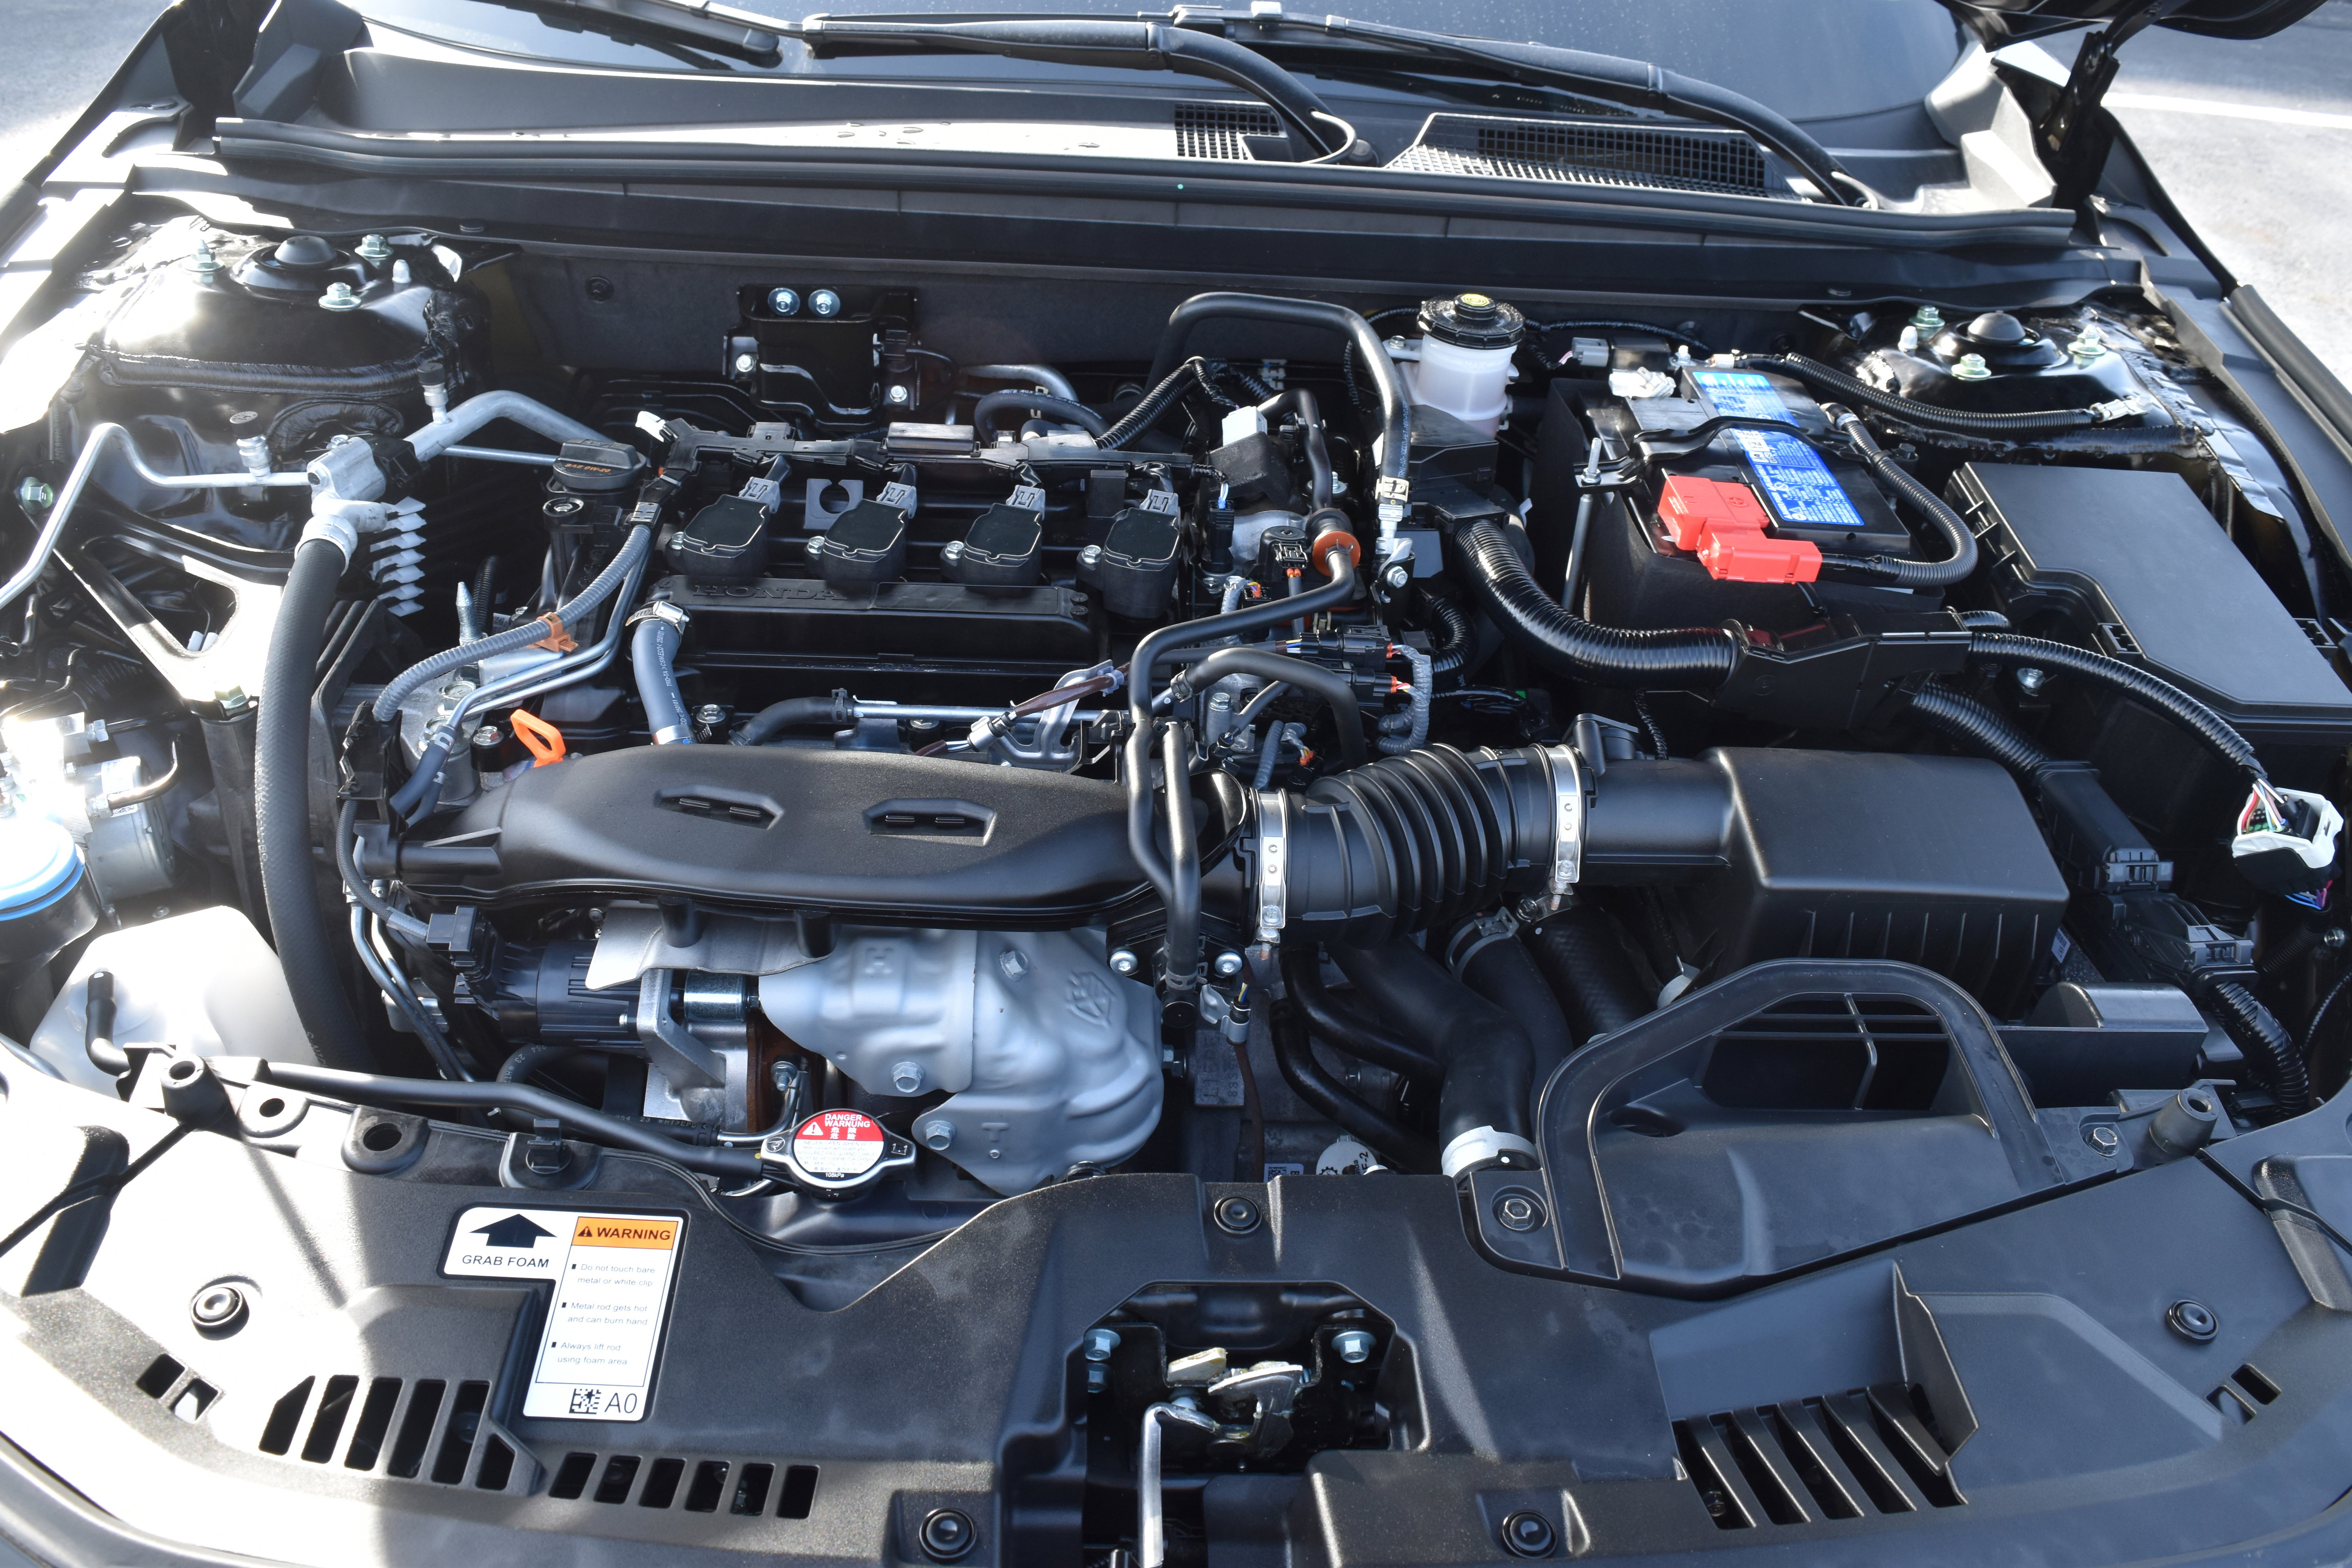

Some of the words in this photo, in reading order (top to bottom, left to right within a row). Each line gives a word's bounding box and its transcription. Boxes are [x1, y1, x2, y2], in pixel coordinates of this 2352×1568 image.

[693, 584, 847, 601] HONDA
[597, 1227, 671, 1241] WARNING
[462, 1255, 503, 1265] GRAB
[508, 1257, 550, 1268] FOAM
[613, 1305, 631, 1313] gets
[561, 1342, 591, 1351] Always
[557, 1356, 580, 1365] using
